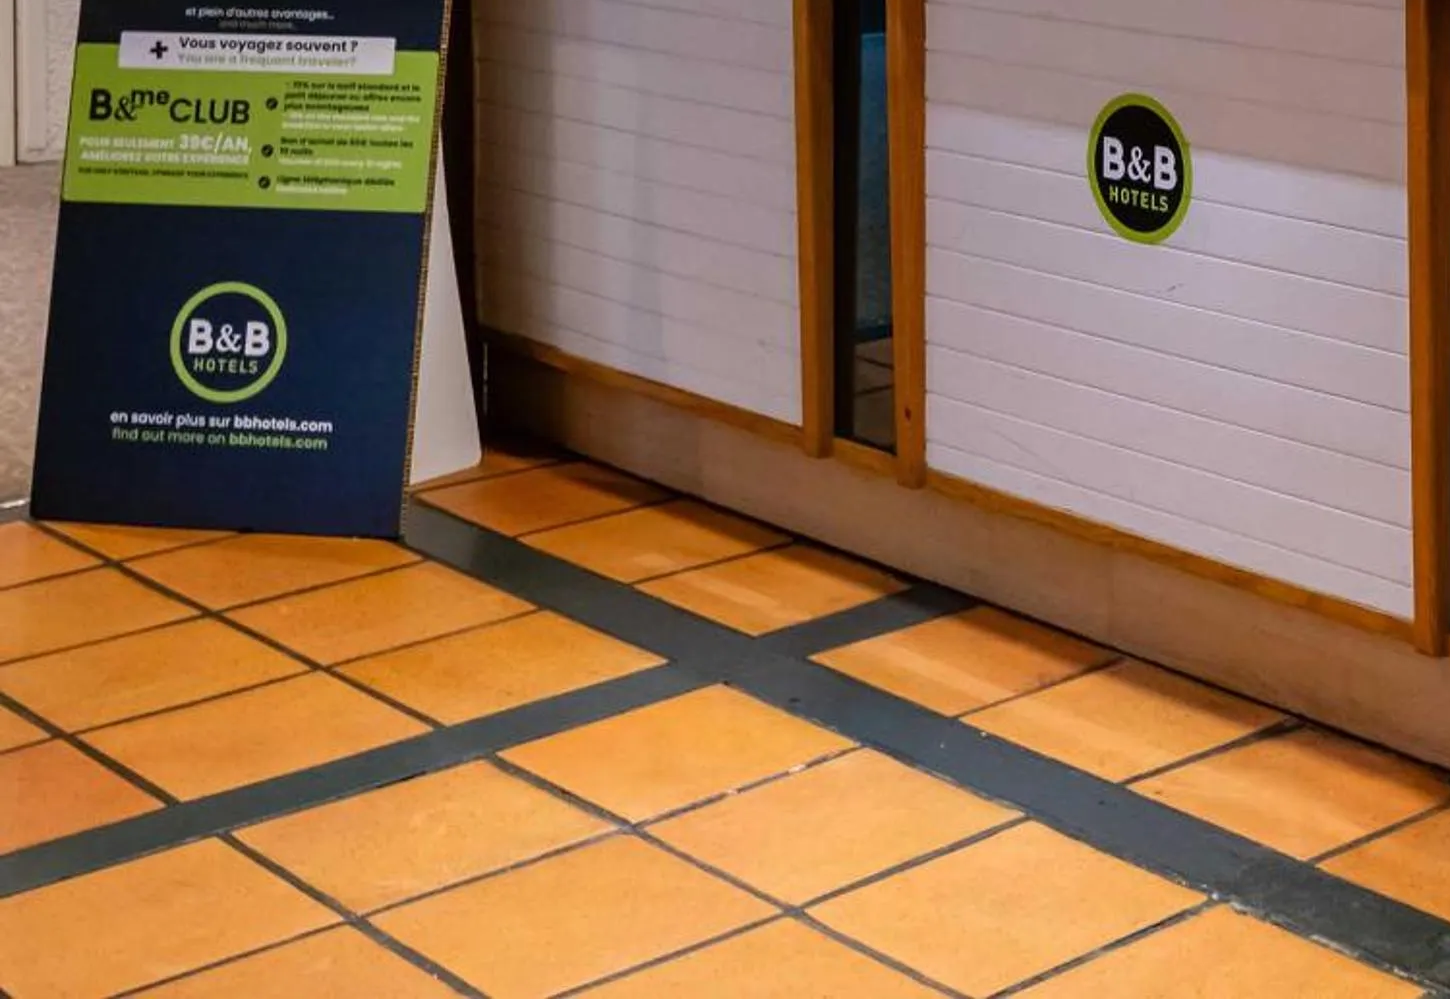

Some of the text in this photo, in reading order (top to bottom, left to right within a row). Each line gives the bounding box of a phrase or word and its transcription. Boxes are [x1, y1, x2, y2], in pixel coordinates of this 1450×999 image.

[179, 36, 359, 53] Vous voyagez souvent ?
[169, 98, 251, 125] CLUB
[1103, 136, 1177, 190] B&B
[1109, 186, 1168, 212] HOTELS
[188, 317, 270, 357] B&B
[193, 358, 258, 375] HOTELS
[110, 411, 334, 433] en savoir plus sur bbhotels.com
[111, 427, 328, 450] find out more on bbhotels.com
